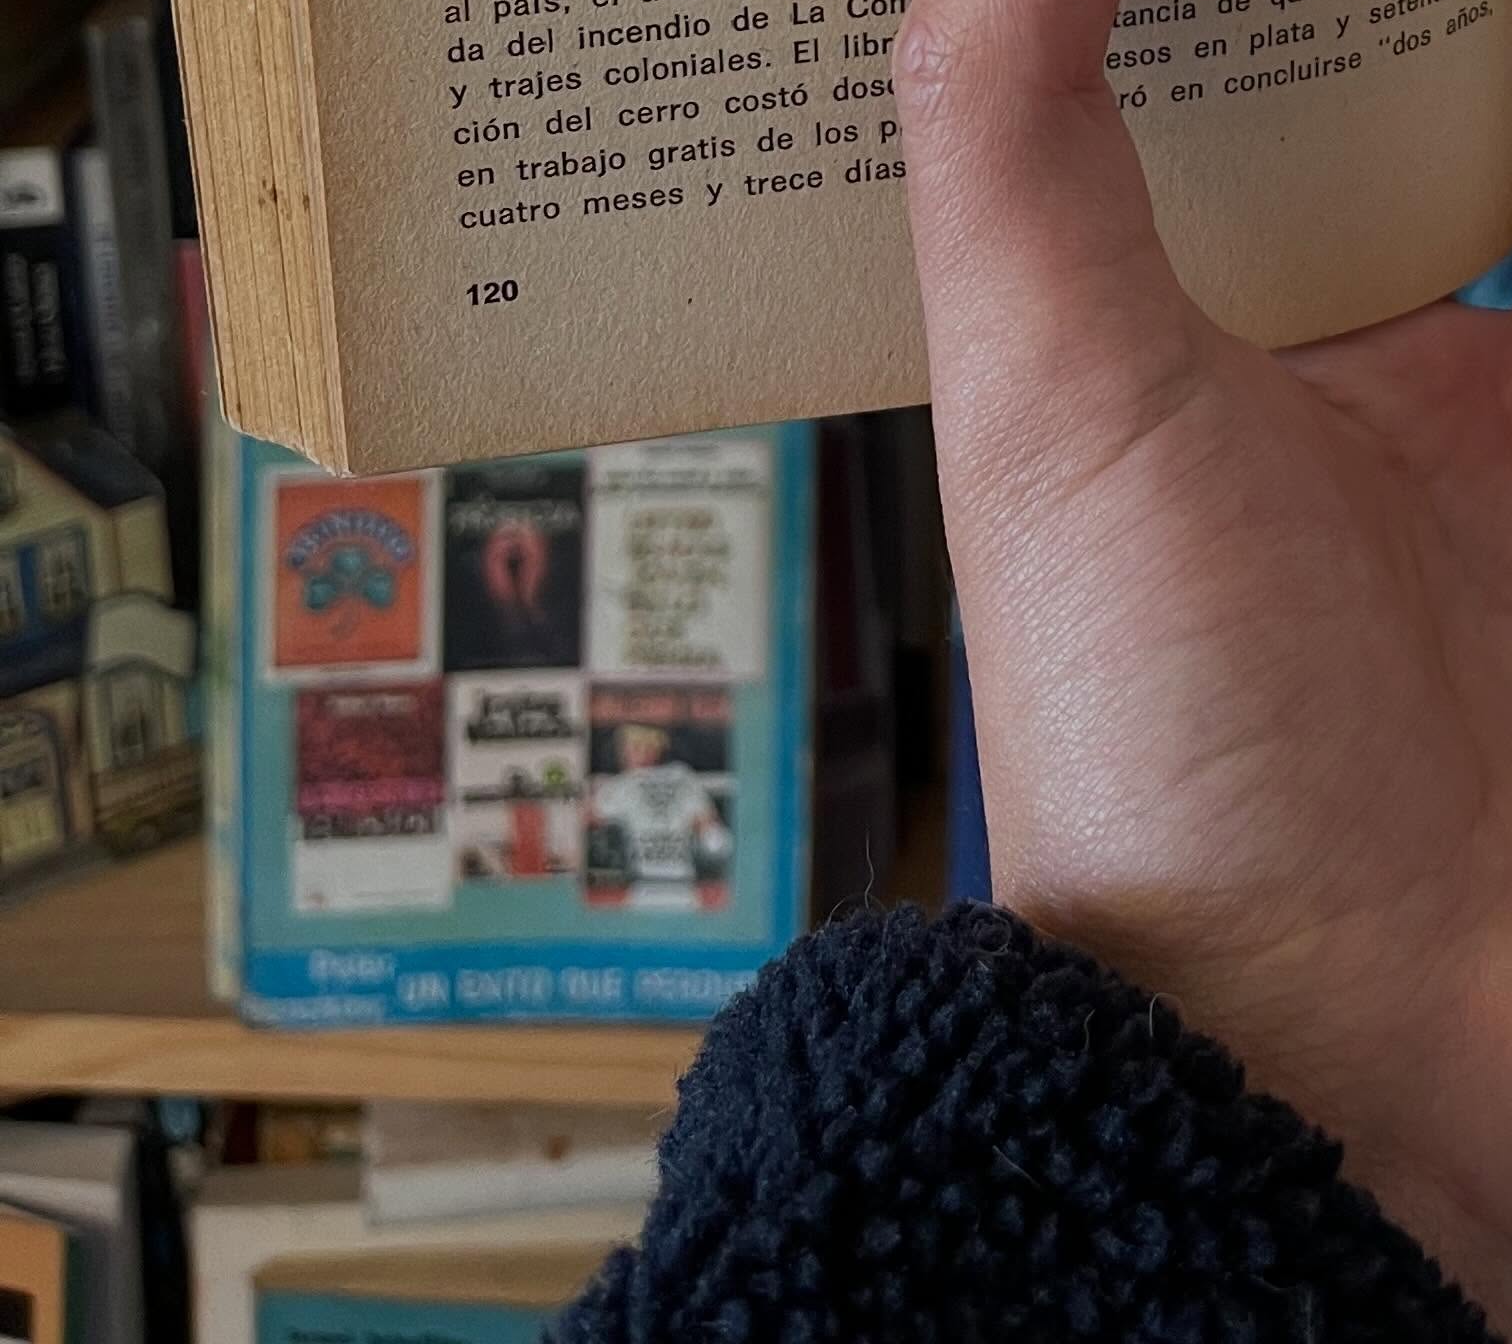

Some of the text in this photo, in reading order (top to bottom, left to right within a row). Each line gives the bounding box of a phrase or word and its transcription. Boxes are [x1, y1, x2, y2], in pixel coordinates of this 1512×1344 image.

[457, 156, 908, 231] cuatro meses y trece días
[465, 278, 520, 308] 120
